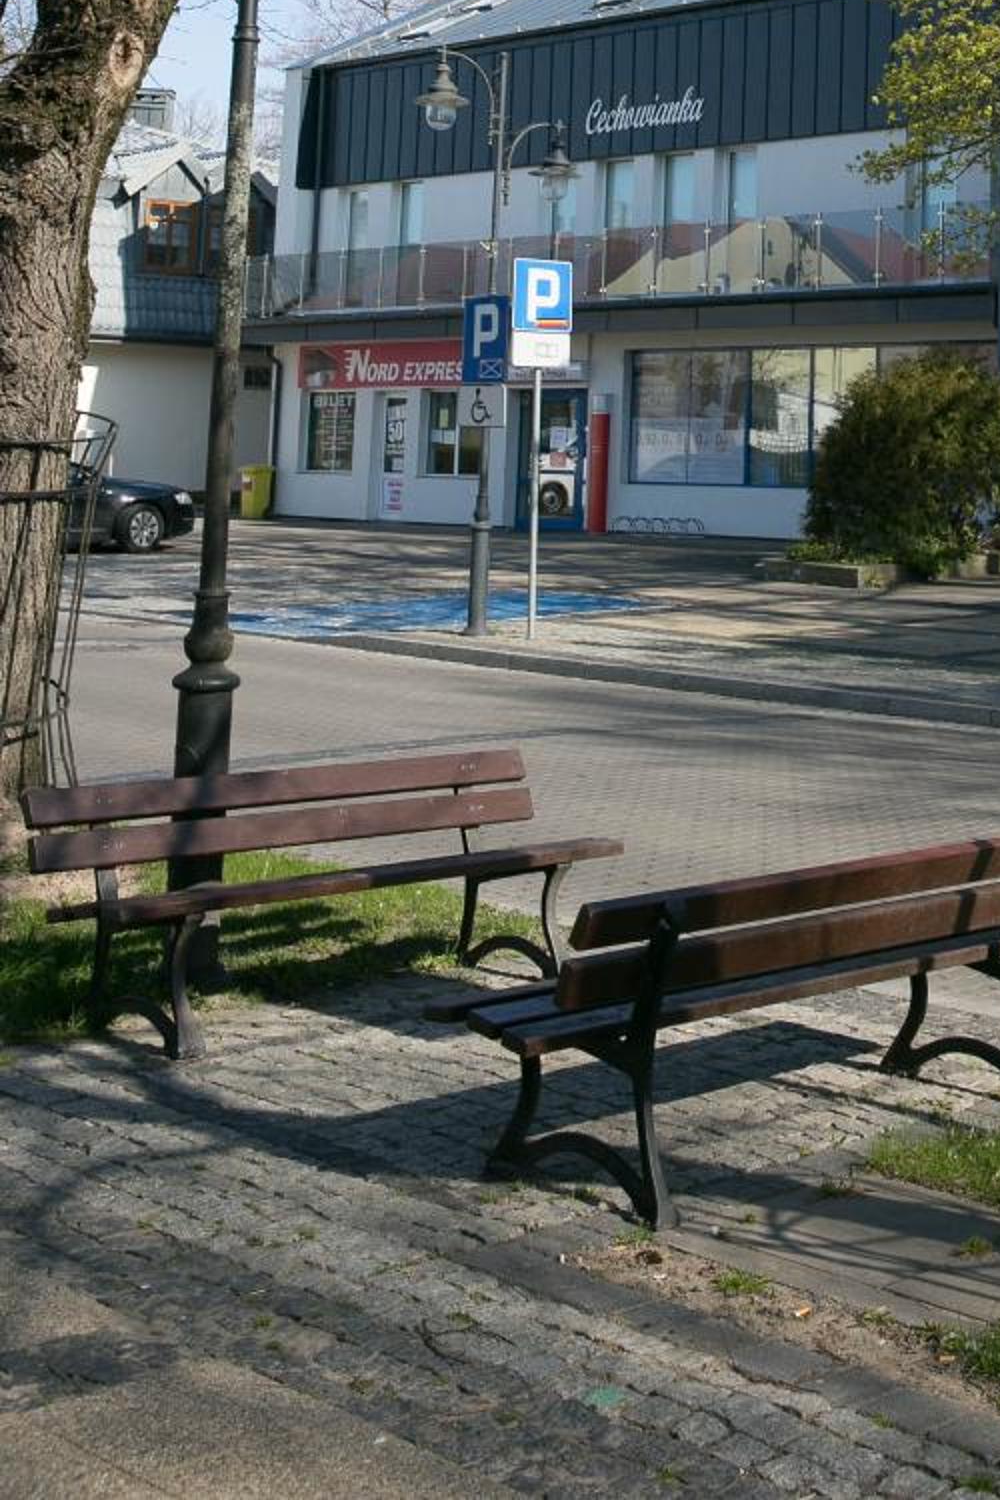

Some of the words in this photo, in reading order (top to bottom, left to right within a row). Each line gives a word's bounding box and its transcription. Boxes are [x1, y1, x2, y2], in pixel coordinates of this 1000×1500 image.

[585, 86, 704, 135] Cechowianka
[527, 268, 560, 322] P
[473, 303, 499, 357] P
[403, 361, 463, 381] EXPRES
